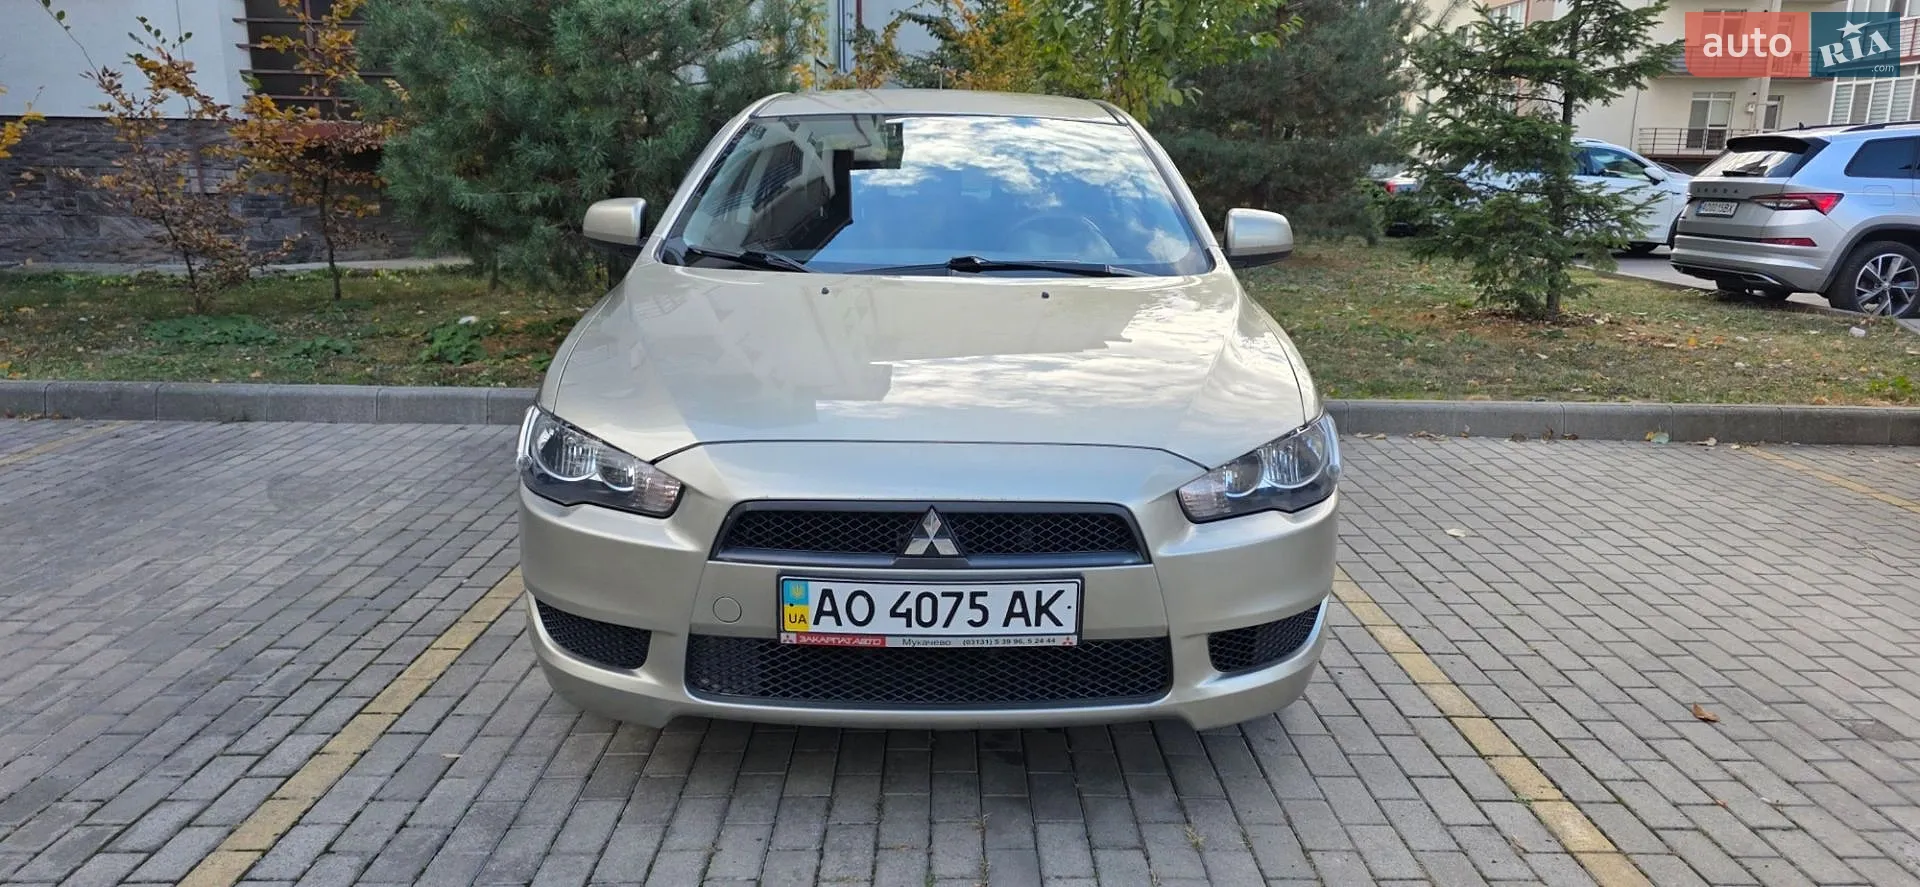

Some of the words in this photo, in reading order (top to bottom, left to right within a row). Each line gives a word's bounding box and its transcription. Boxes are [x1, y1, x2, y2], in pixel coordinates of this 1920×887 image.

[812, 588, 875, 627] AO
[889, 591, 990, 628] 4075
[1002, 590, 1066, 628] AK
[788, 613, 807, 624] UA
[902, 637, 952, 648] Мукачево
